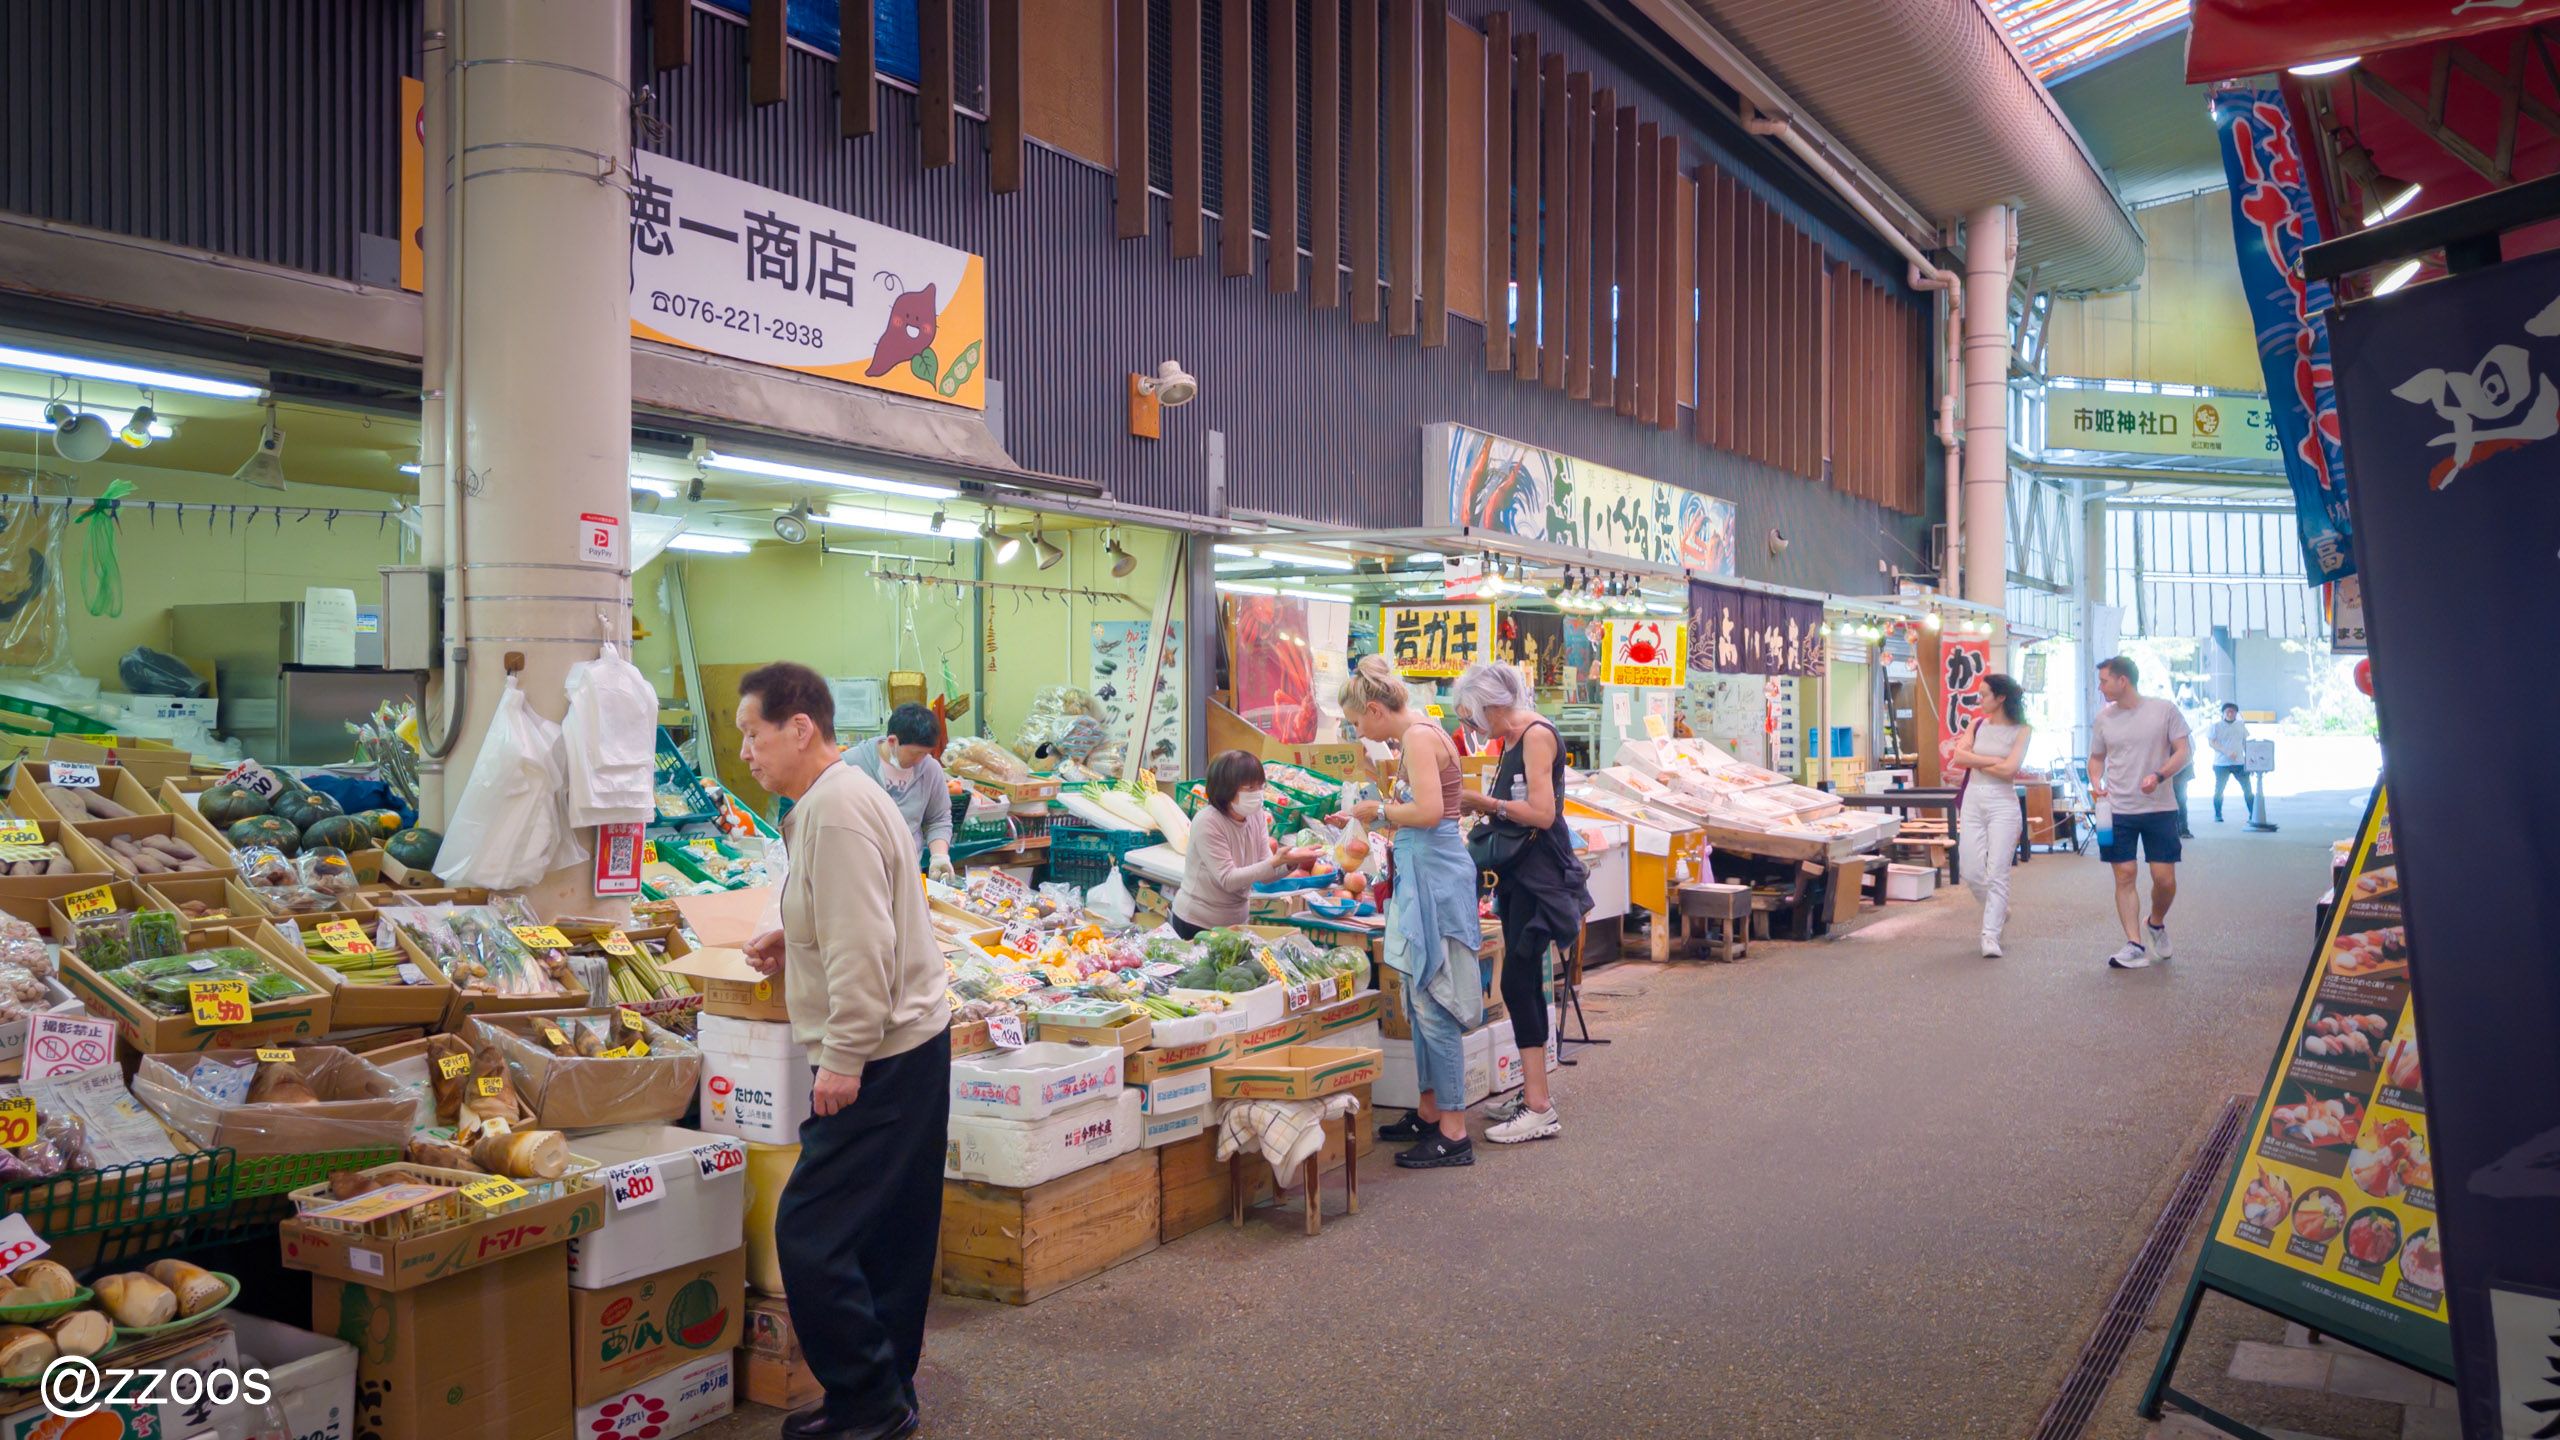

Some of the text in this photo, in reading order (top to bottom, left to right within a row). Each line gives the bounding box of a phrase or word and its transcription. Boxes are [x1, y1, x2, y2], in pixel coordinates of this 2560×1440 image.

[671, 293, 824, 348] 076-221-2938
[2074, 408, 2178, 435] 市姫神社口
[589, 547, 612, 558] PayPay
[1394, 609, 1478, 663] 岩ガキ
[1126, 629, 1139, 703] 加賀野菜
[1624, 666, 1658, 675] こちらで
[1617, 674, 1668, 686] 召し上がれます
[1946, 646, 1985, 735] かに
[1324, 753, 1355, 765] きゅうり
[58, 774, 96, 785] 2500
[1483, 870, 1499, 888] D
[42, 1019, 103, 1038] 撮影禁止
[972, 1086, 1004, 1099] みょうが
[1063, 1077, 1098, 1095] みょうが
[734, 1087, 773, 1107] たけのこ
[628, 1175, 654, 1199] 800
[478, 1224, 548, 1258] トマト
[601, 1310, 664, 1362] 西瓜
